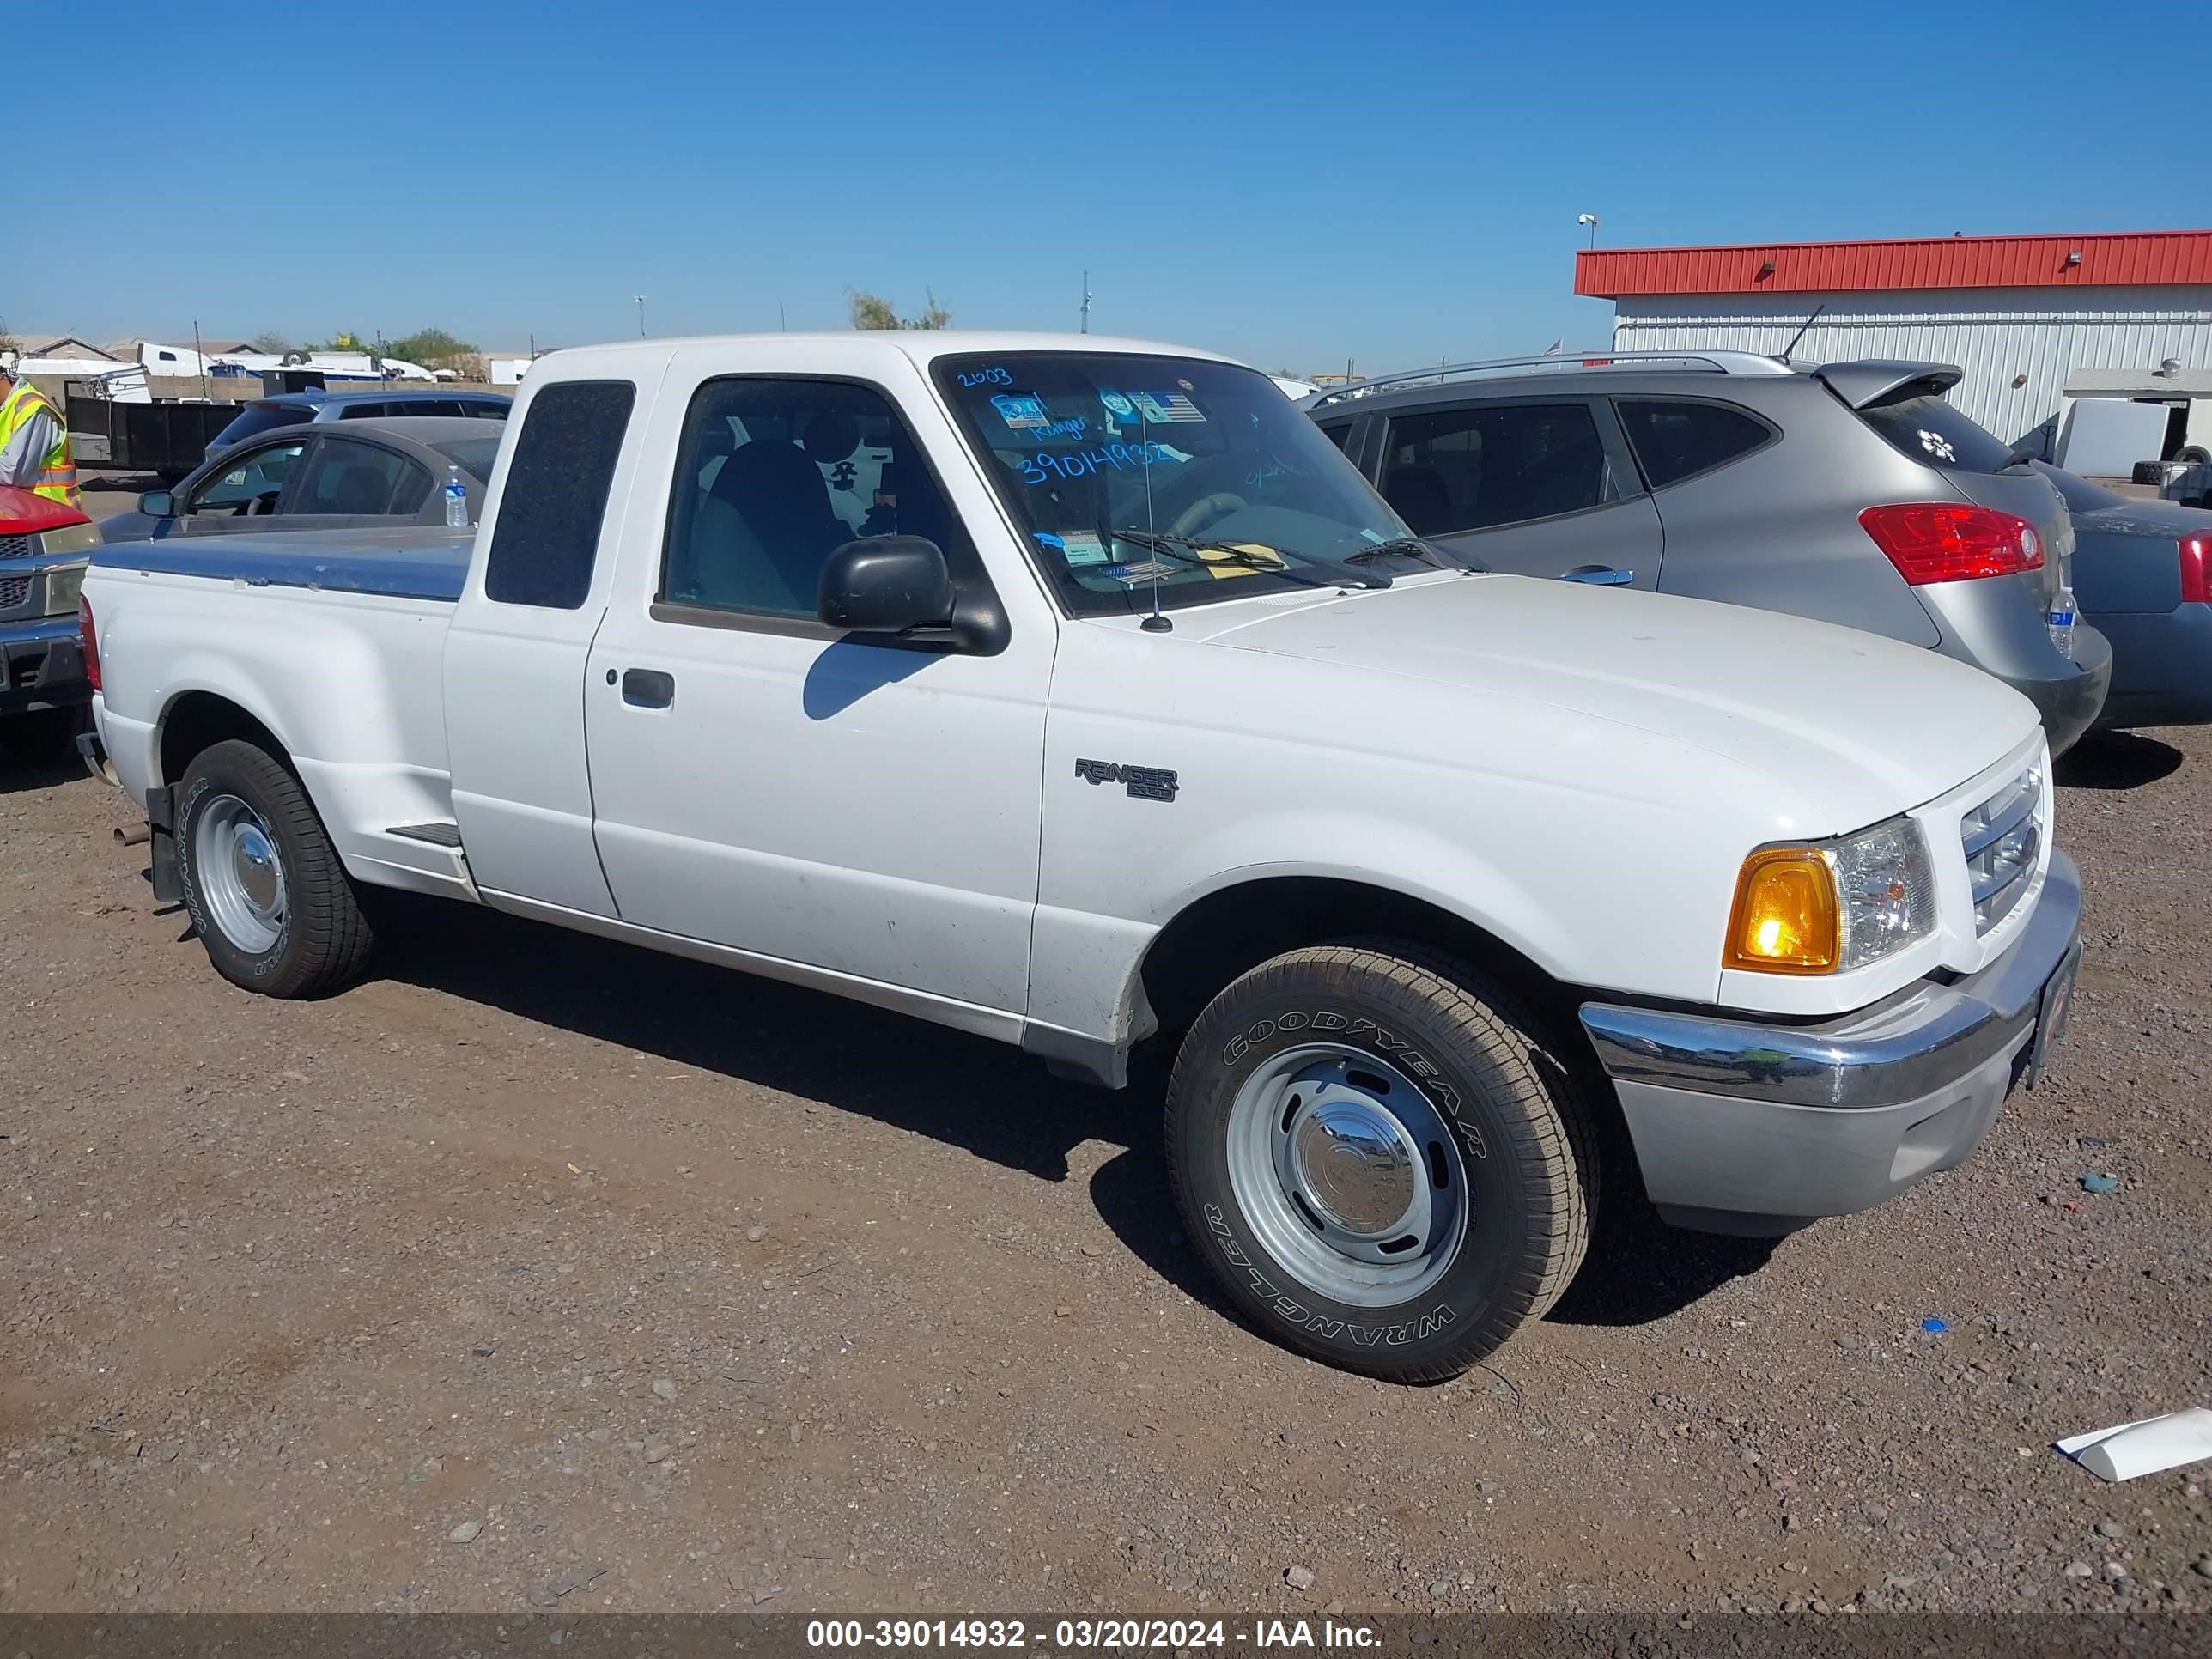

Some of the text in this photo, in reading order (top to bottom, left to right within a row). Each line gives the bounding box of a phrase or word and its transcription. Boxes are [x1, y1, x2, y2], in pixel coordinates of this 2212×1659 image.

[957, 368, 1014, 387] 2003
[1027, 416, 1086, 441] Ranger
[1016, 441, 1171, 484] 39014932
[1223, 1011, 1487, 1159] GOODYEAR
[1204, 1202, 1457, 1346] WRANGLER
